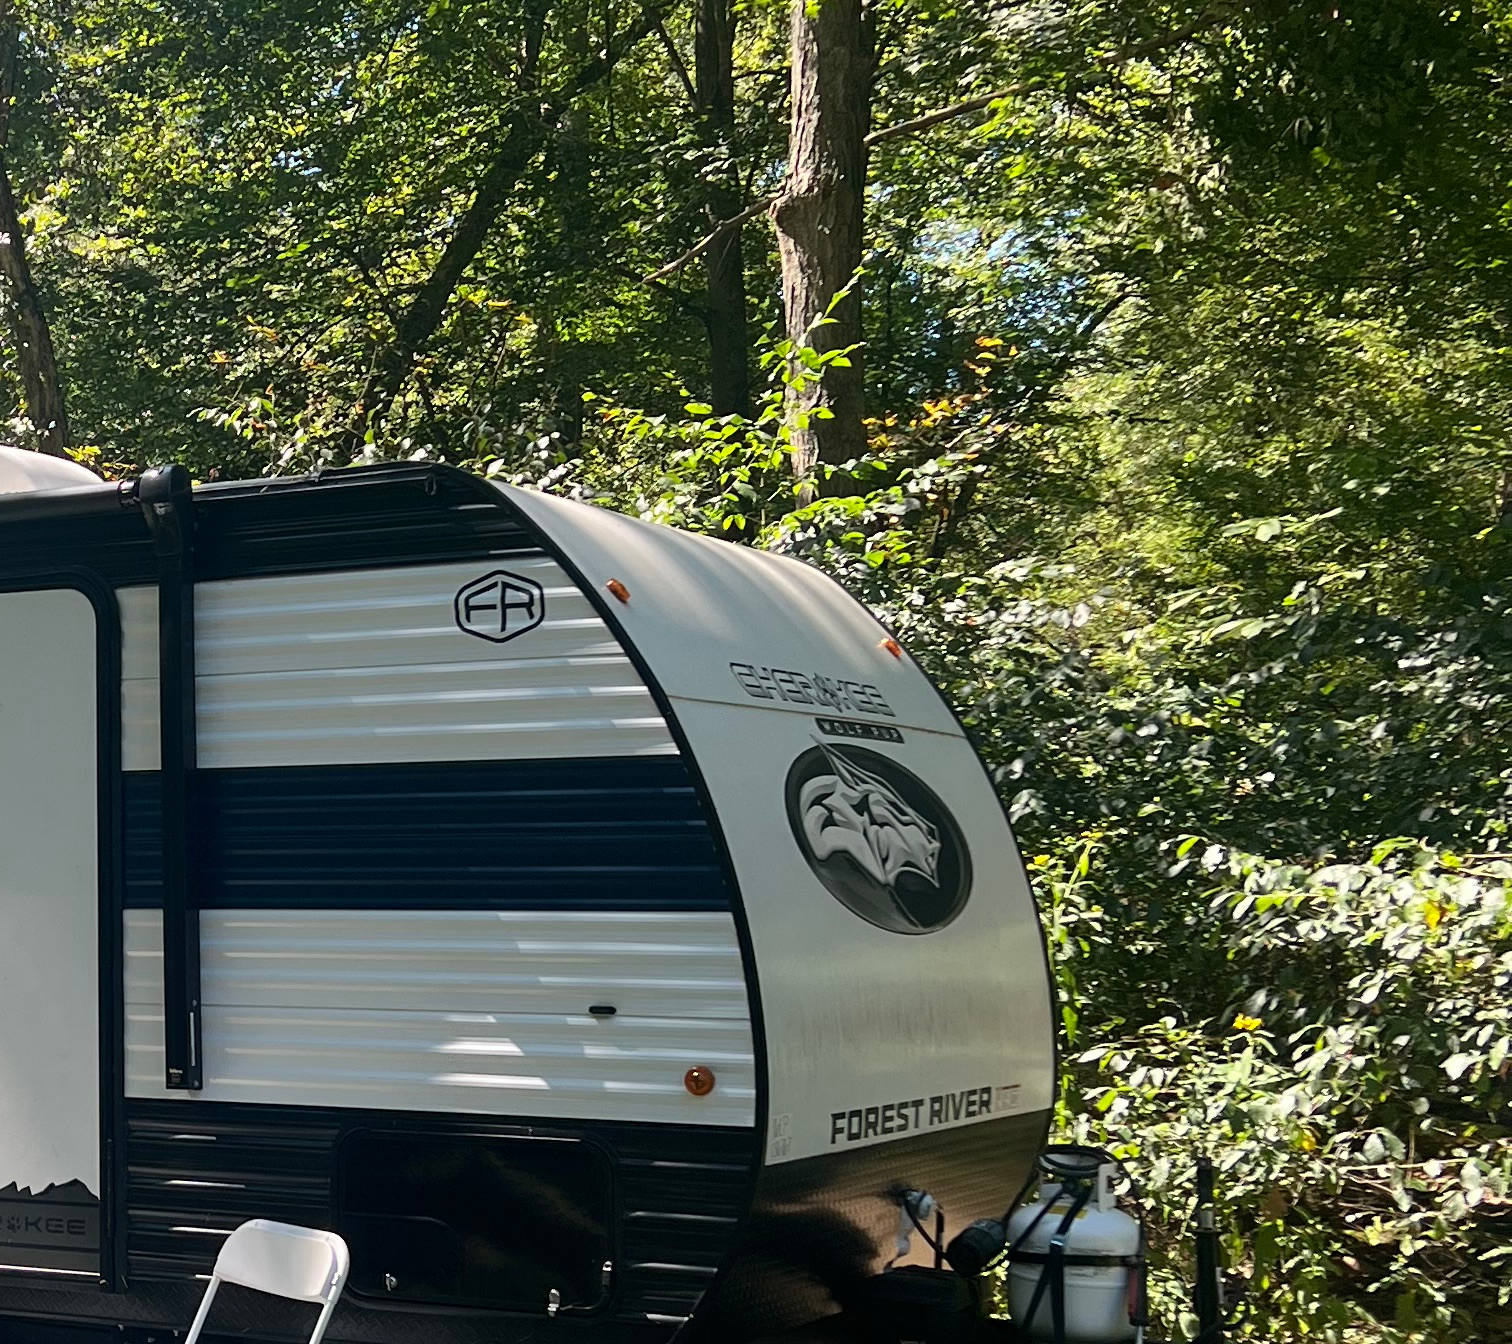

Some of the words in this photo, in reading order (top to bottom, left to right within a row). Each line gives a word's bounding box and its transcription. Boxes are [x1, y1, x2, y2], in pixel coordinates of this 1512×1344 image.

[464, 579, 535, 633] FR
[830, 1098, 925, 1145] FOREST
[928, 1085, 993, 1126] RIVER
